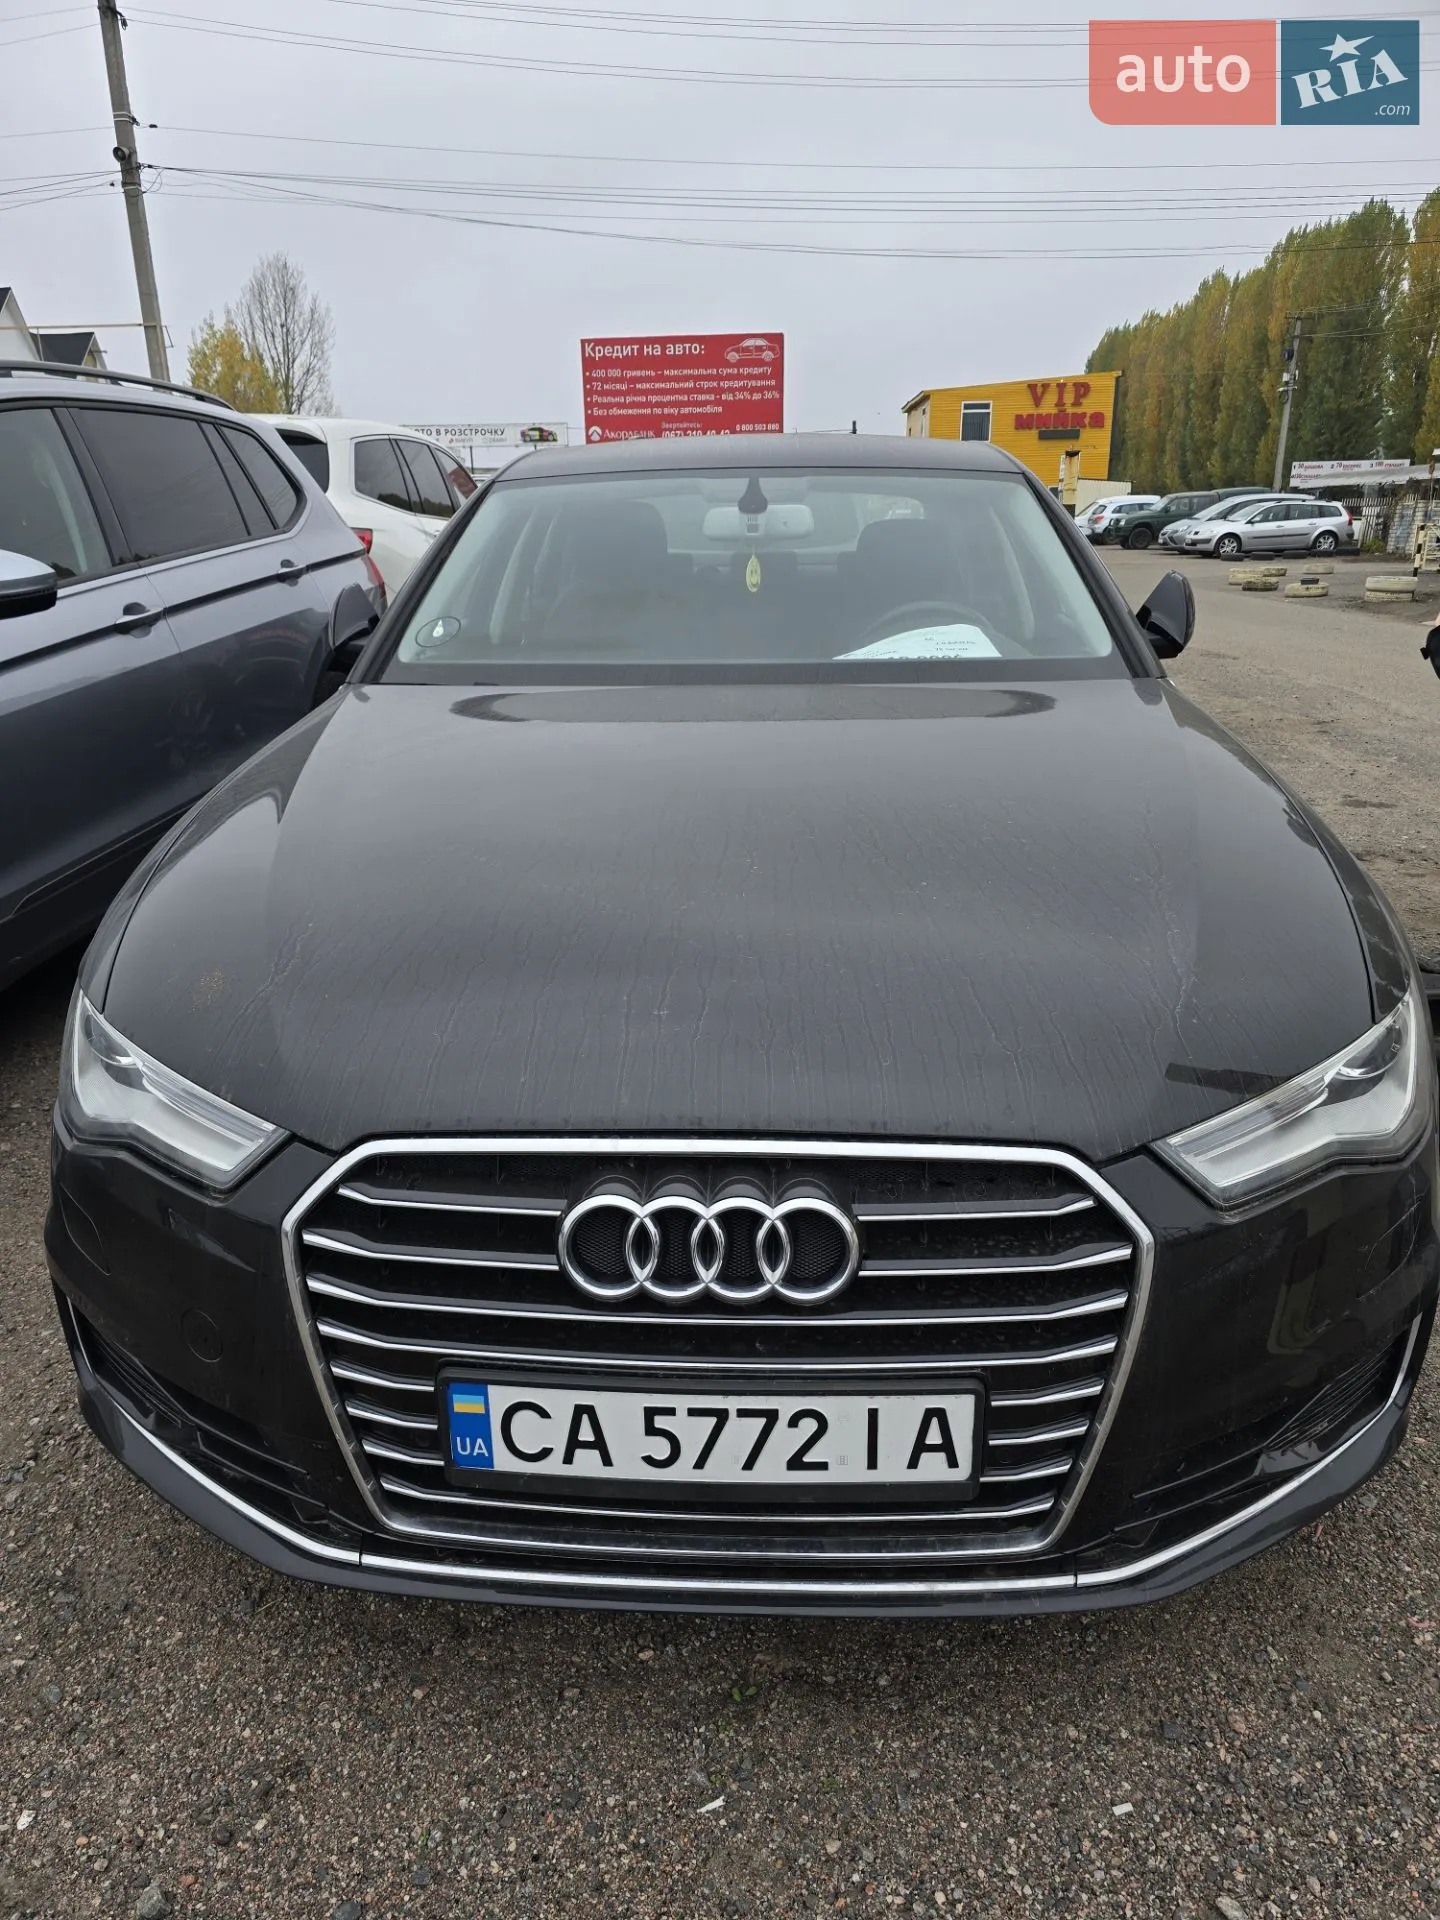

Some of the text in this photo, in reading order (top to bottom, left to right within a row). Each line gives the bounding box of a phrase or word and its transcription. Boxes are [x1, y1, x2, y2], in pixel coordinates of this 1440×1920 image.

[585, 342, 705, 360] Кредит на авто:
[591, 368, 606, 378] 400
[607, 369, 621, 377] 000
[623, 369, 656, 379] гривень
[663, 367, 717, 377] максимальна
[718, 367, 738, 376] сума
[739, 366, 772, 376] кредиту
[592, 382, 602, 390] 72
[603, 381, 628, 391] місяці
[635, 380, 694, 389] максимальний
[695, 381, 718, 390] строк
[719, 379, 776, 388] кредитування
[592, 394, 624, 403] Реальна
[626, 394, 646, 404] річна
[647, 394, 688, 403] процентна
[689, 393, 715, 401] ставка
[721, 391, 734, 401] від
[734, 391, 751, 400] 34%
[752, 392, 762, 401] до
[763, 390, 779, 399] 36%
[1027, 382, 1091, 407] VIP
[593, 404, 723, 416] Без обмеження по віку автомобіля
[435, 428, 442, 437] В
[444, 428, 505, 436] РОЗСТРОЧКУ
[500, 1400, 960, 1471] CA 5772 IA
[456, 1436, 489, 1457] UA
